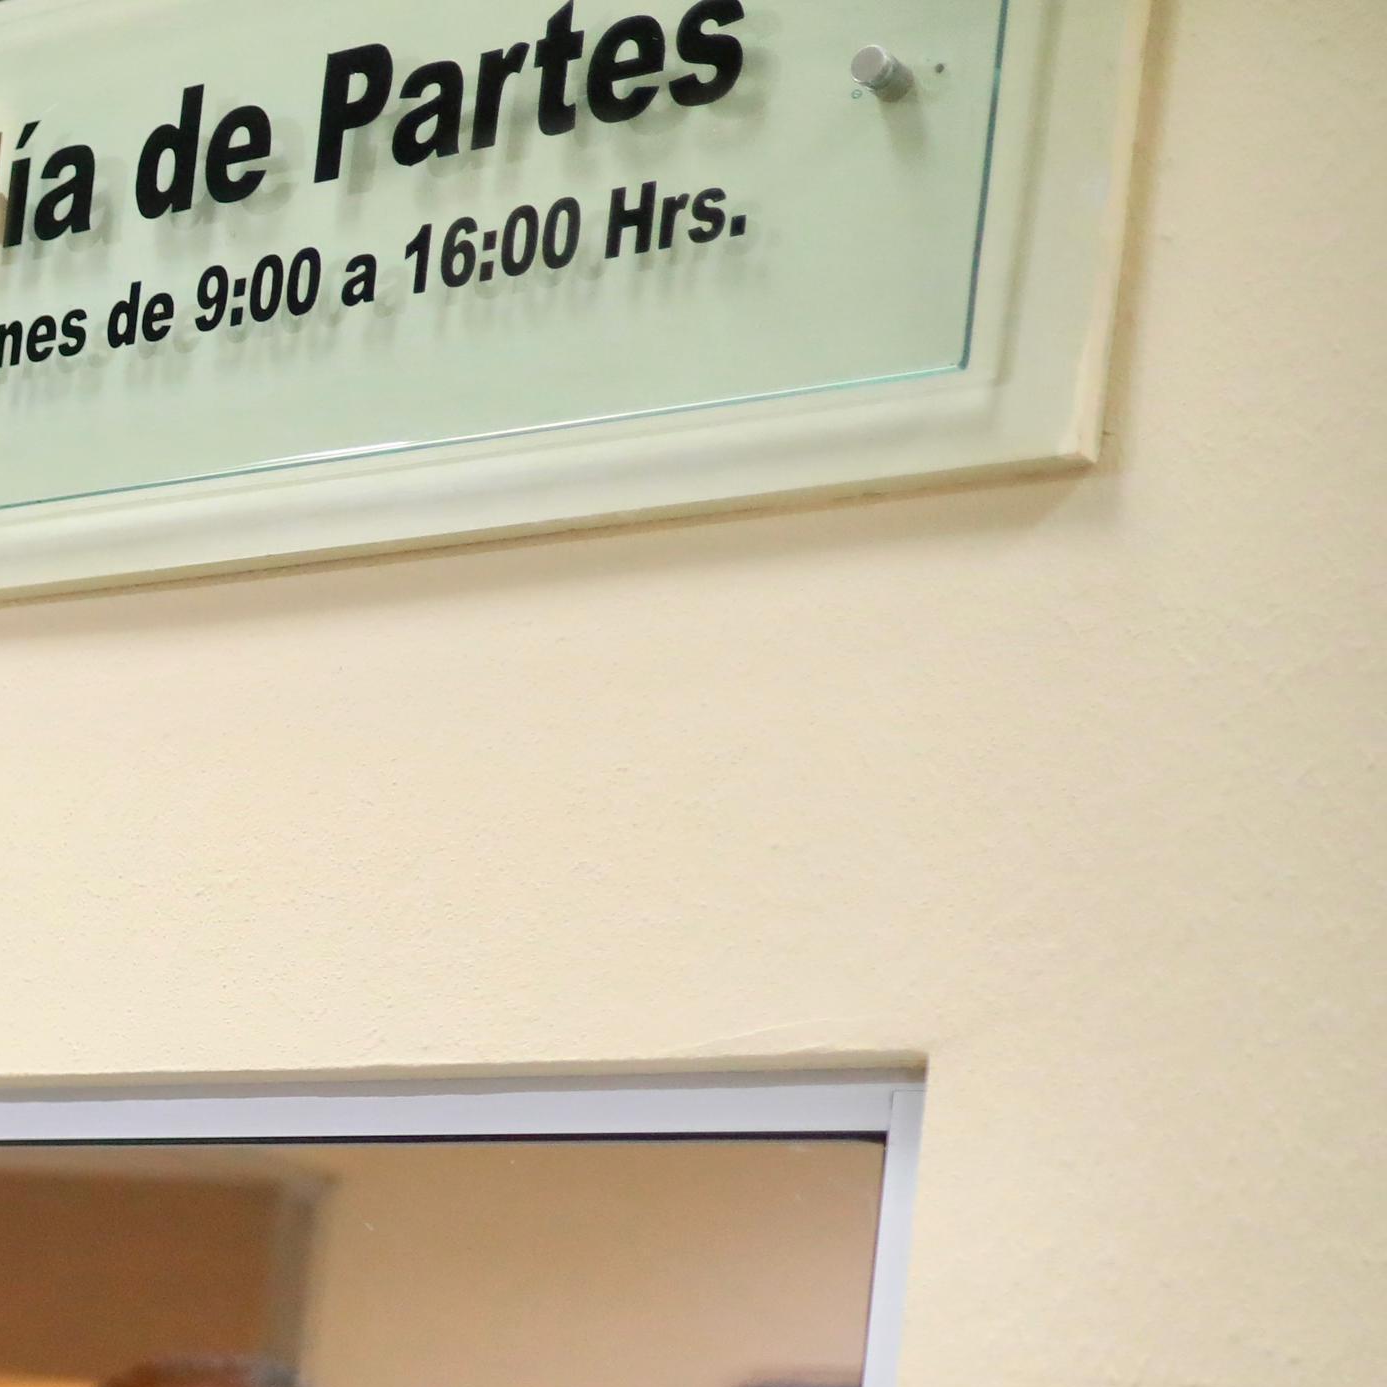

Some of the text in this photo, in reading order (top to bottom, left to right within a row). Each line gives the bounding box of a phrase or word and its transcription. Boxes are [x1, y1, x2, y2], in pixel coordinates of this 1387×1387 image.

[135, 83, 272, 219] de
[314, 0, 745, 183] Partes
[107, 281, 174, 348] de
[195, 246, 321, 332] 9:00
[342, 253, 377, 307] a
[404, 196, 581, 294] 16:00
[605, 181, 747, 259] Hrs.
